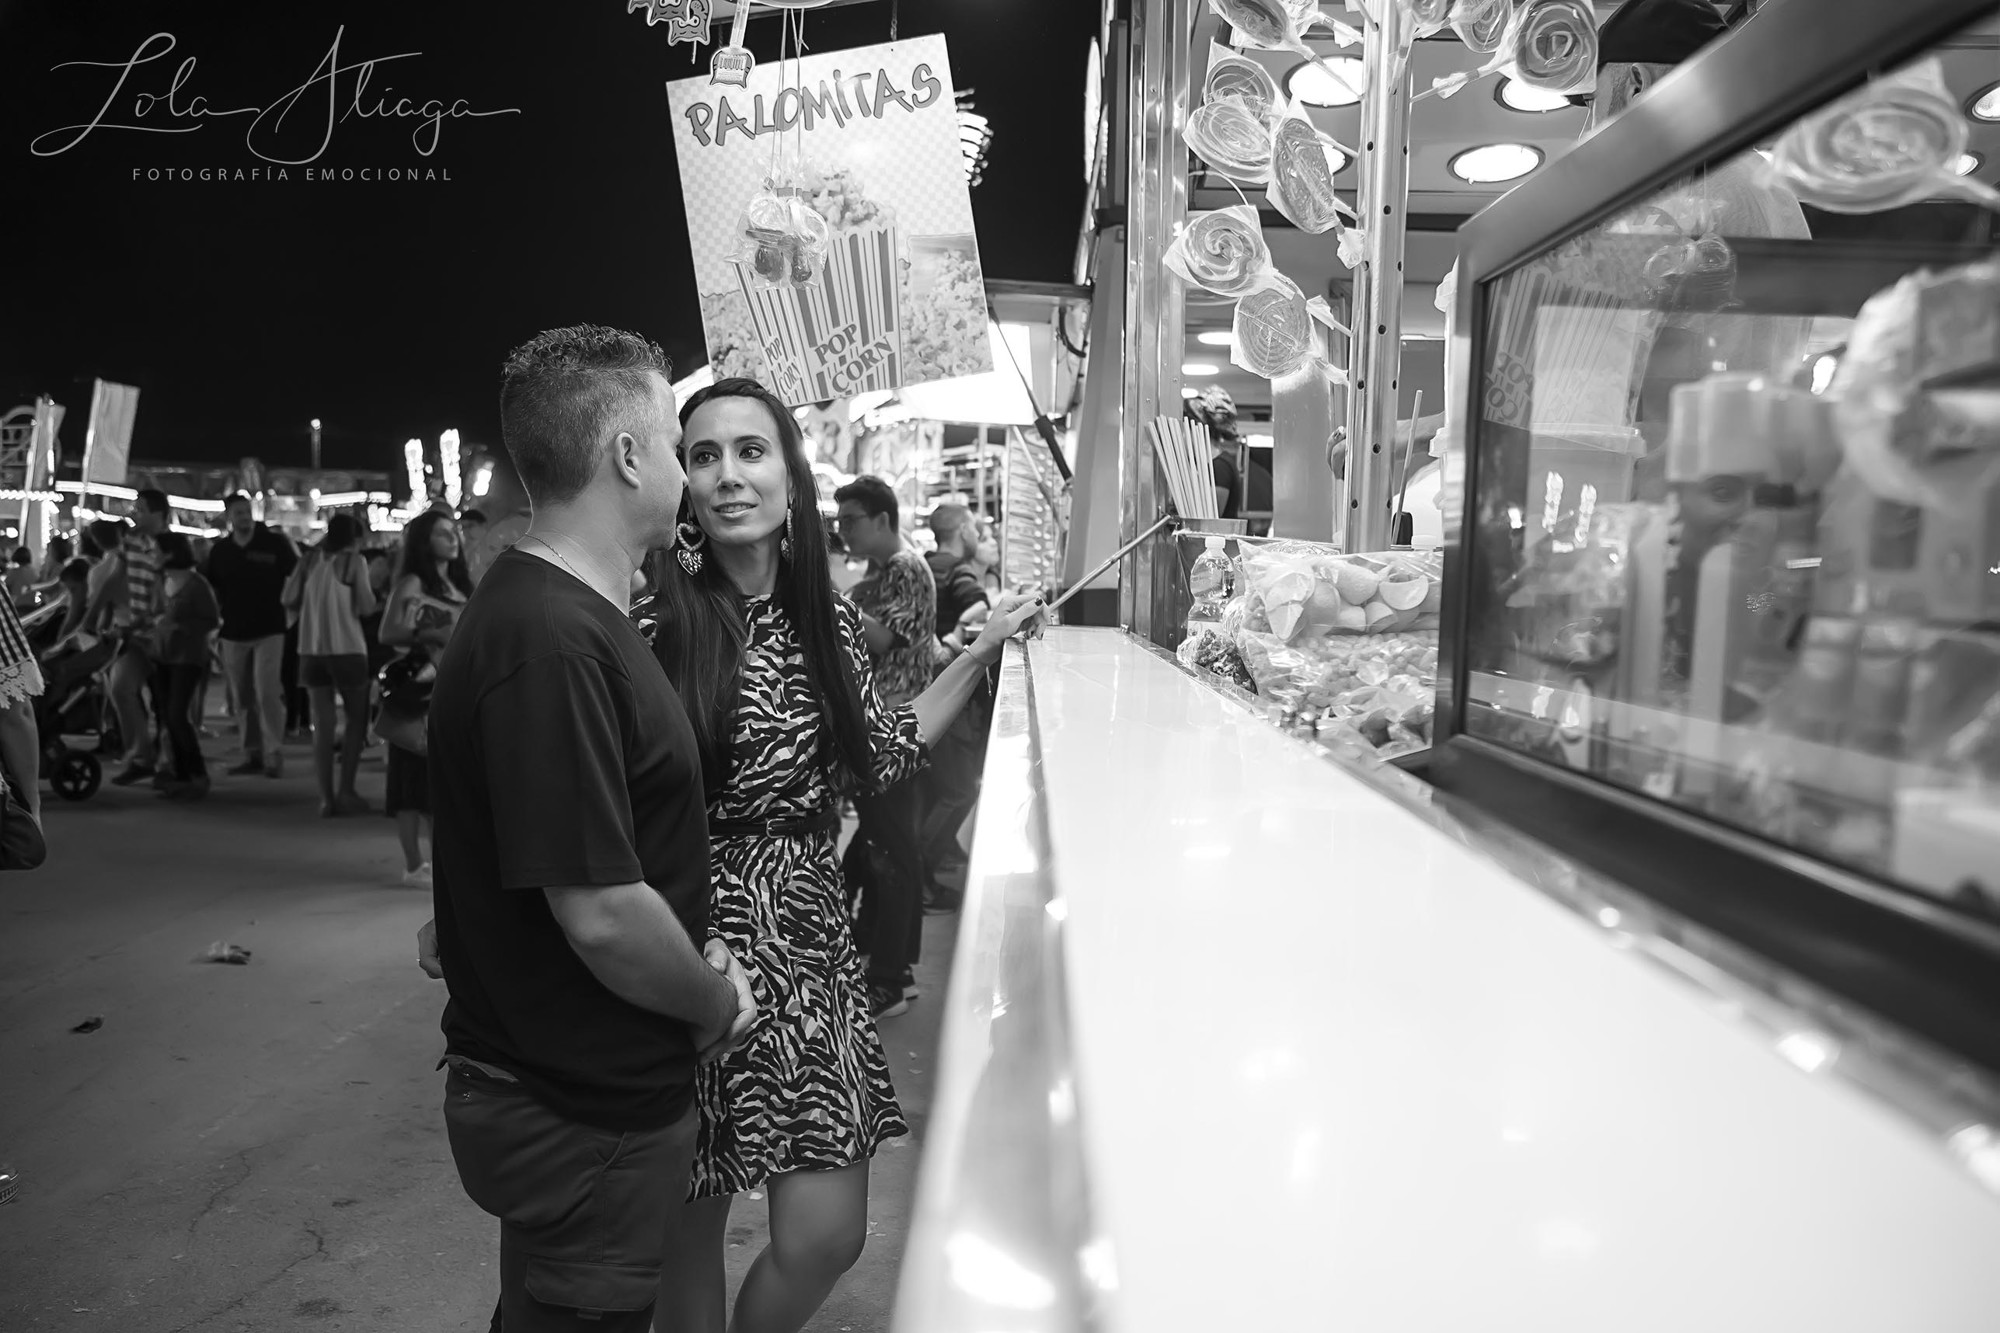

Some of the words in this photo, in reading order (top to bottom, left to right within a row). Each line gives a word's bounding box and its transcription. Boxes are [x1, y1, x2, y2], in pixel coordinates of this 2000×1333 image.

[765, 337, 782, 366] POP
[814, 323, 857, 366] POP
[832, 336, 893, 393] CORN
